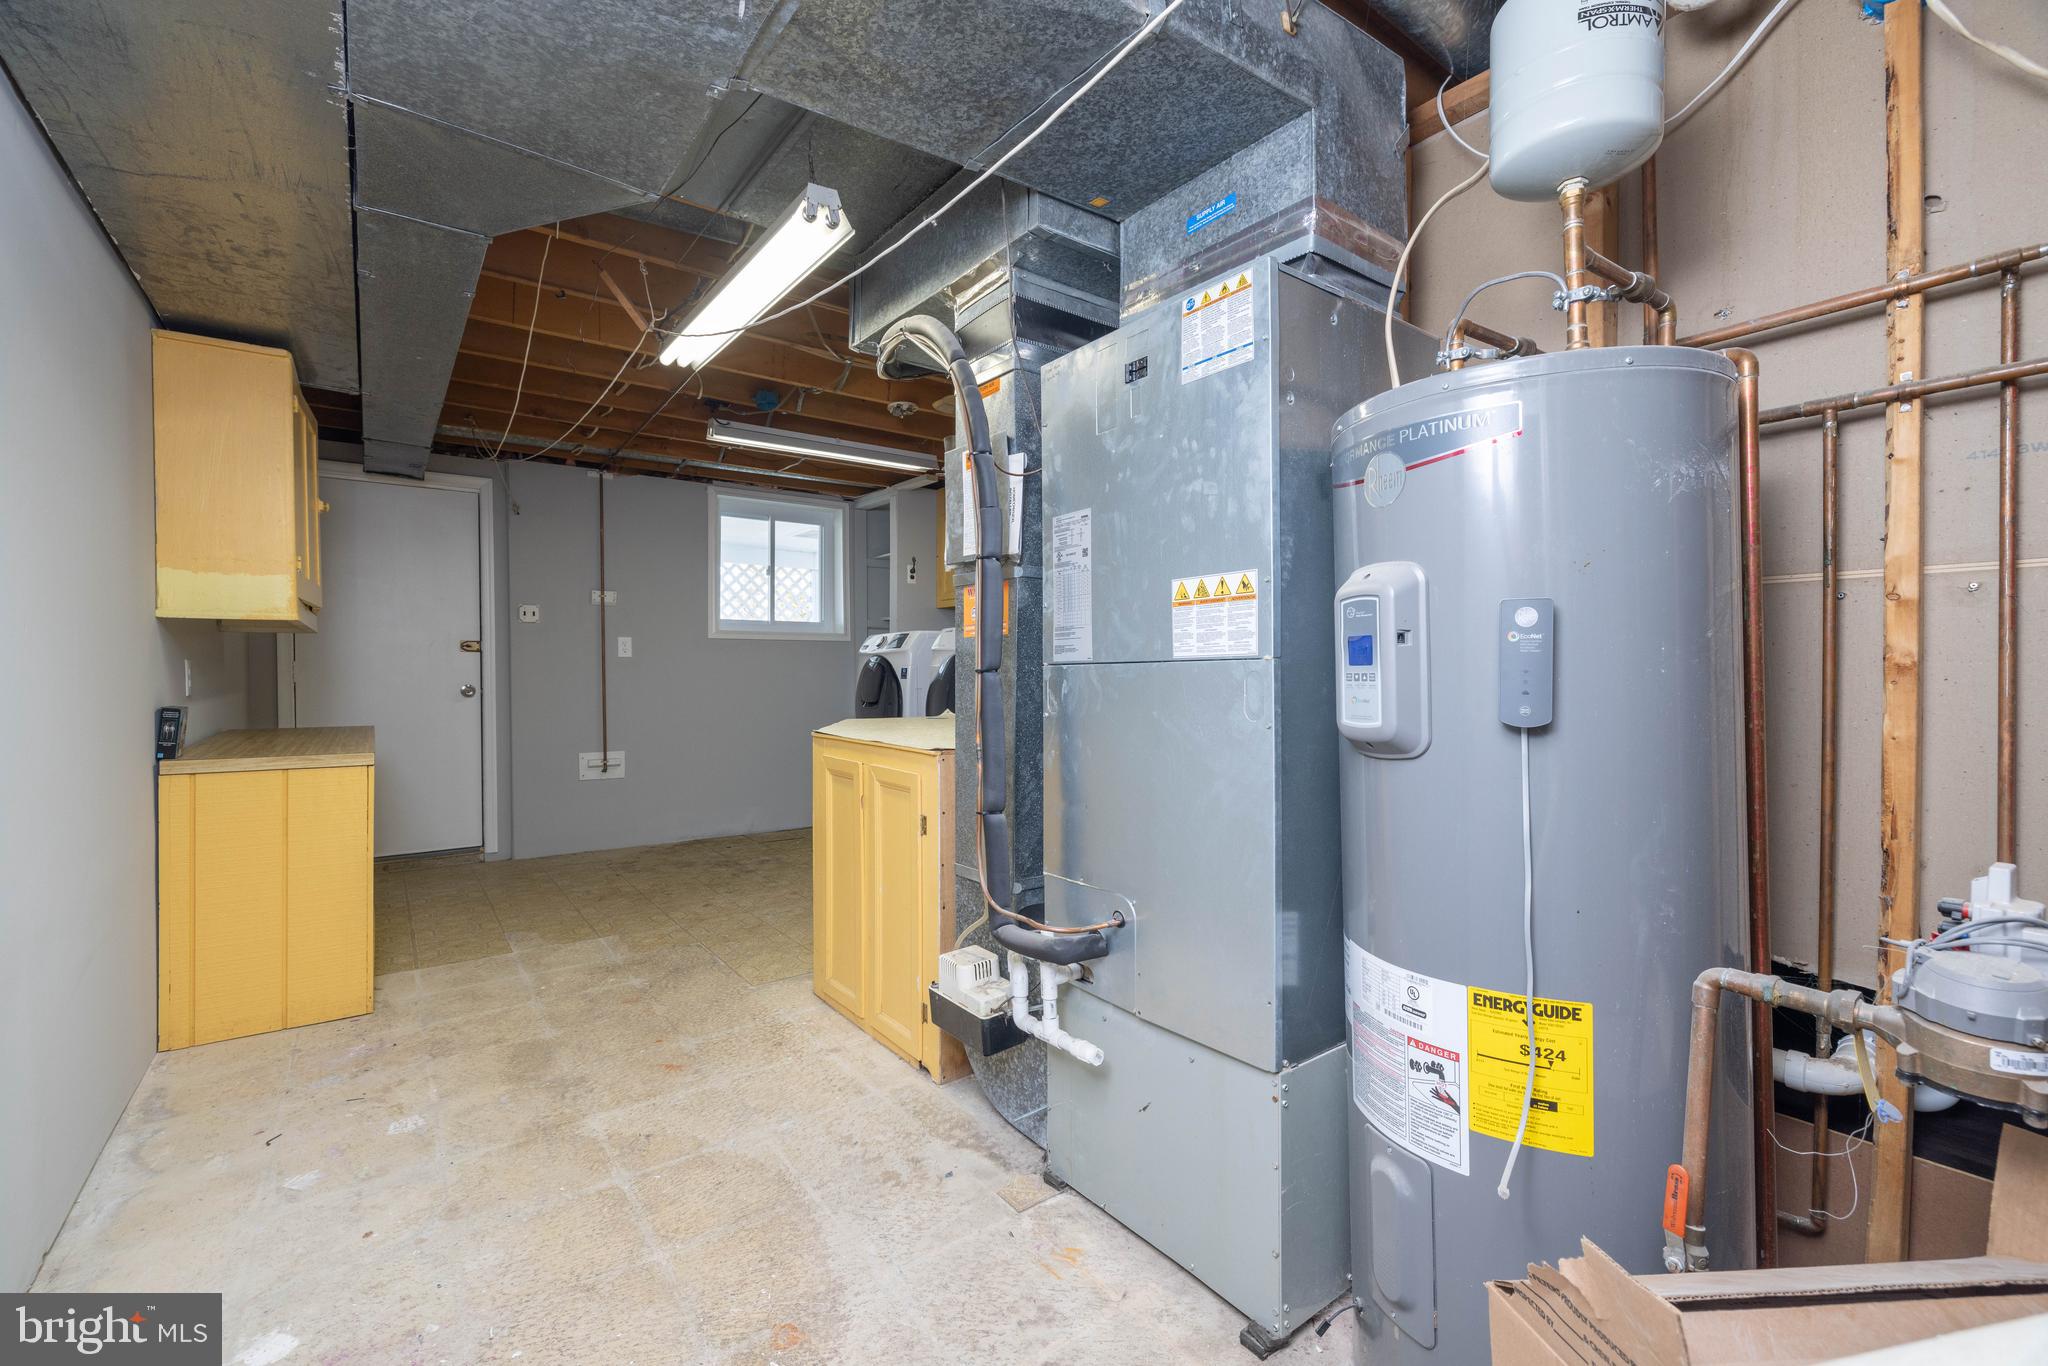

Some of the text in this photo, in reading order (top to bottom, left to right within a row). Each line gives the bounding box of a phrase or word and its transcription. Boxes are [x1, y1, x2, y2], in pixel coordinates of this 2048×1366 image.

[1578, 13, 1653, 31] AMTROL
[1216, 199, 1226, 209] AIR
[1399, 412, 1491, 444] PLATINUM
[1366, 452, 1404, 498] Rheem
[1418, 1042, 1457, 1061] DANGER
[1519, 1043, 1567, 1062] $424
